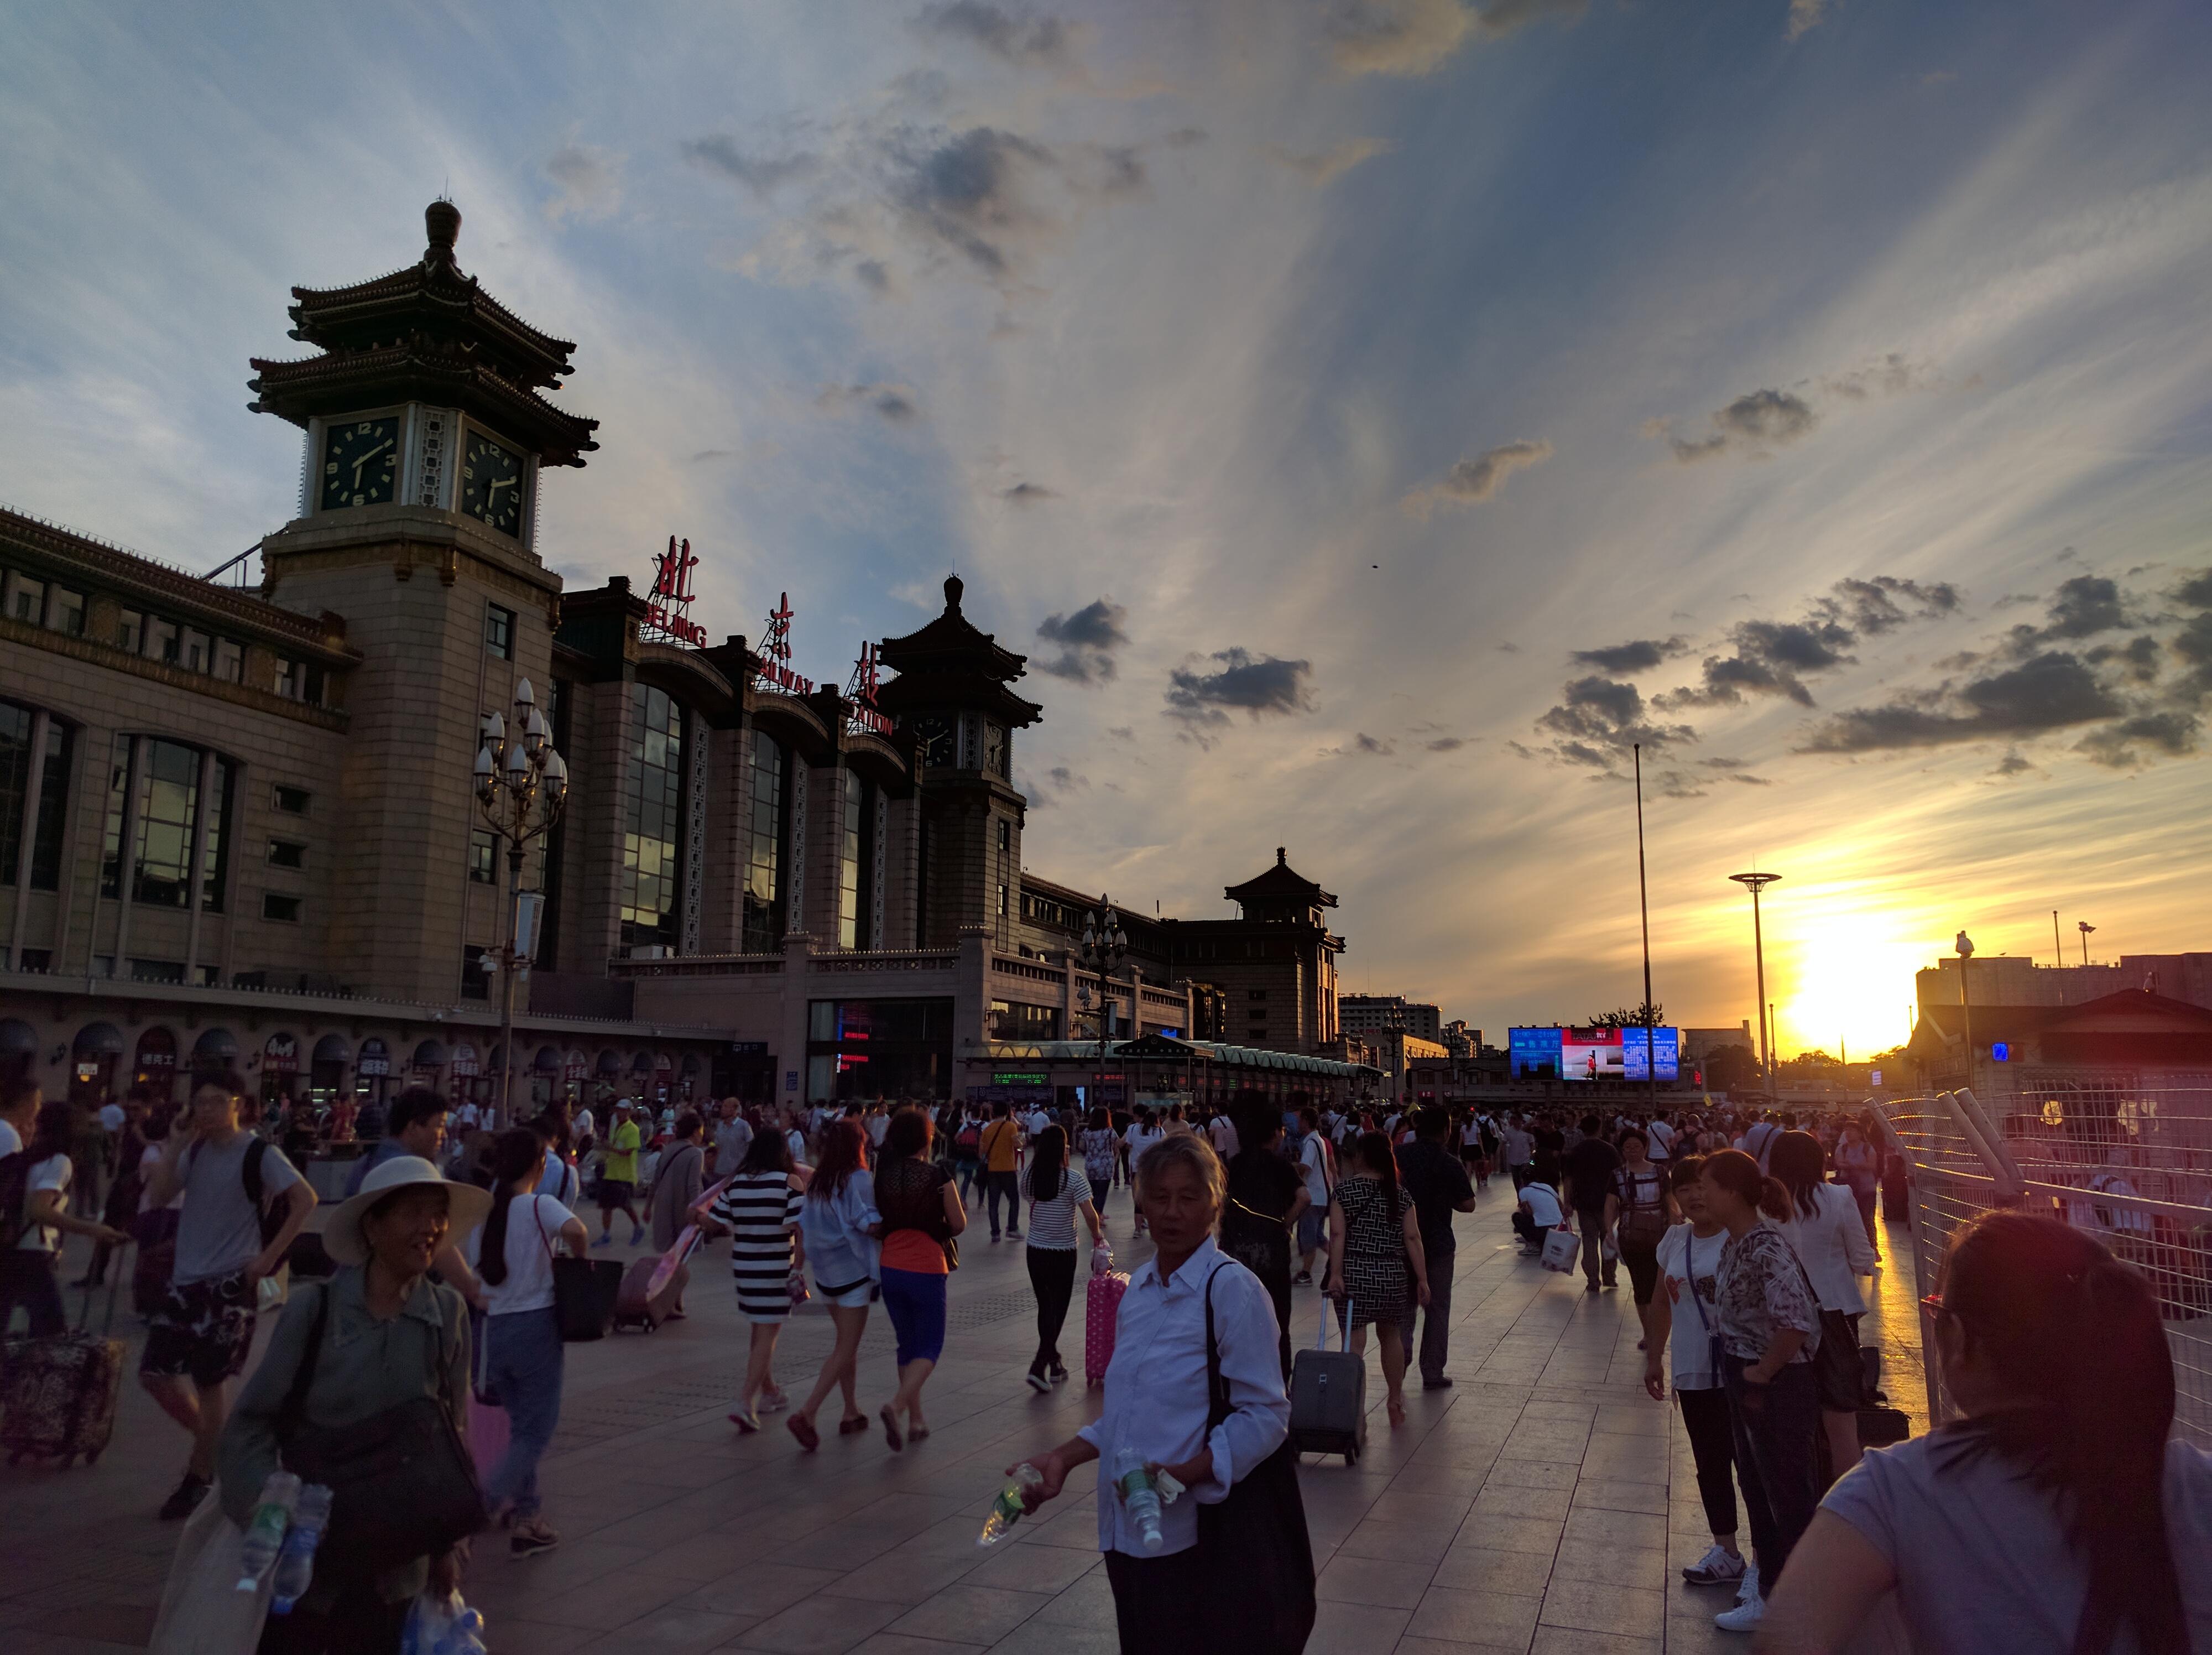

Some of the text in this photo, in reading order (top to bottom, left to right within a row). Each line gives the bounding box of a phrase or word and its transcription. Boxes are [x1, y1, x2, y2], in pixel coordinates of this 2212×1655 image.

[358, 422, 371, 435] 12
[489, 443, 500, 458] 12
[385, 454, 397, 467] 3
[326, 462, 338, 475] 9
[352, 494, 365, 506] 6
[510, 490, 520, 504] 3
[484, 513, 495, 527] 6
[760, 657, 815, 699] AILWAY
